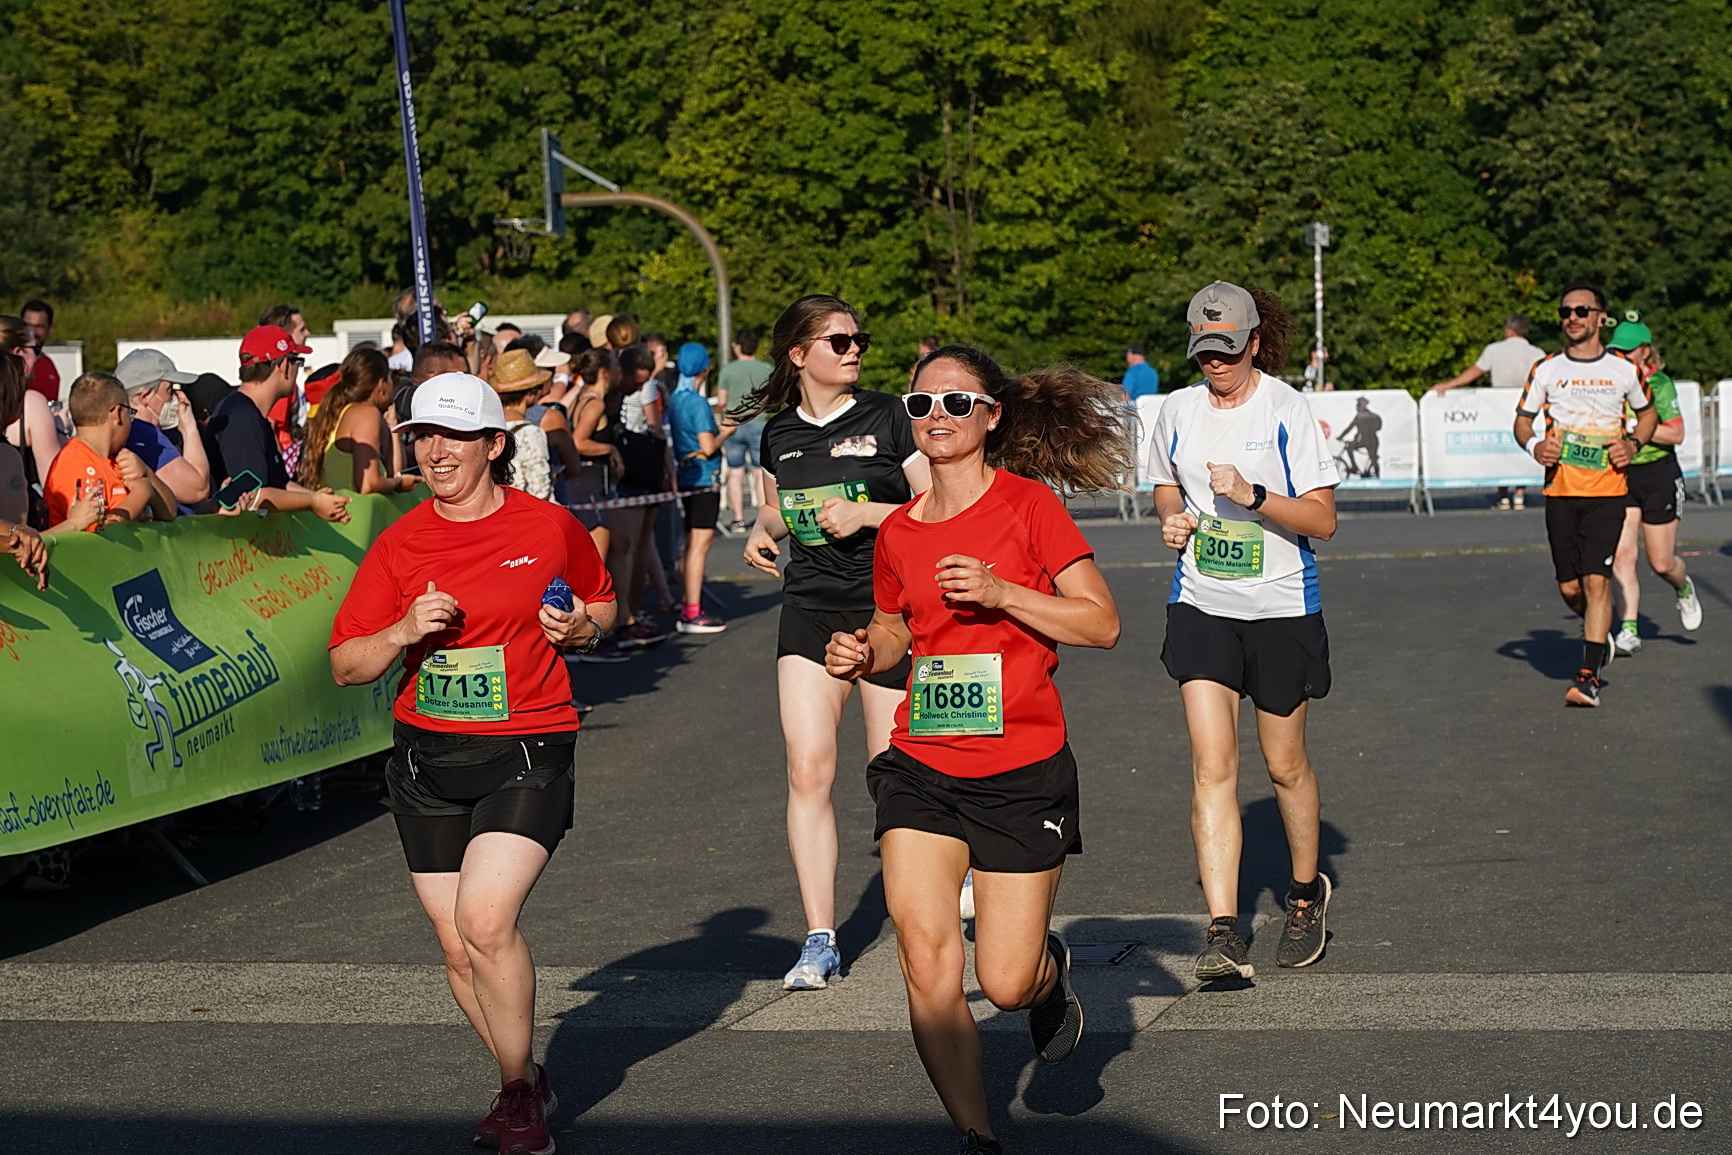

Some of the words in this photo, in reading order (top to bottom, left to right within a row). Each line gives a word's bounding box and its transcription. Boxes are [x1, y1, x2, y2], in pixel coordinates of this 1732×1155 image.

[1571, 387, 1617, 396] DYNAMICS
[438, 403, 463, 411] quattro
[464, 407, 475, 416] Cup
[1444, 409, 1478, 423] NOW
[1573, 444, 1599, 459] 367
[1206, 536, 1244, 560] 305
[1251, 544, 1260, 571] 2022
[510, 556, 528, 568] DEHN
[132, 607, 168, 633] Fischer
[425, 673, 489, 698] 1713
[491, 676, 503, 711] 2022
[922, 682, 984, 710] 1688
[452, 700, 493, 709] Susanne
[913, 693, 921, 720] RUN
[920, 712, 949, 720] Hollweck
[950, 711, 987, 719] Christine
[986, 686, 998, 723] 2022
[186, 712, 235, 758] neumarkt
